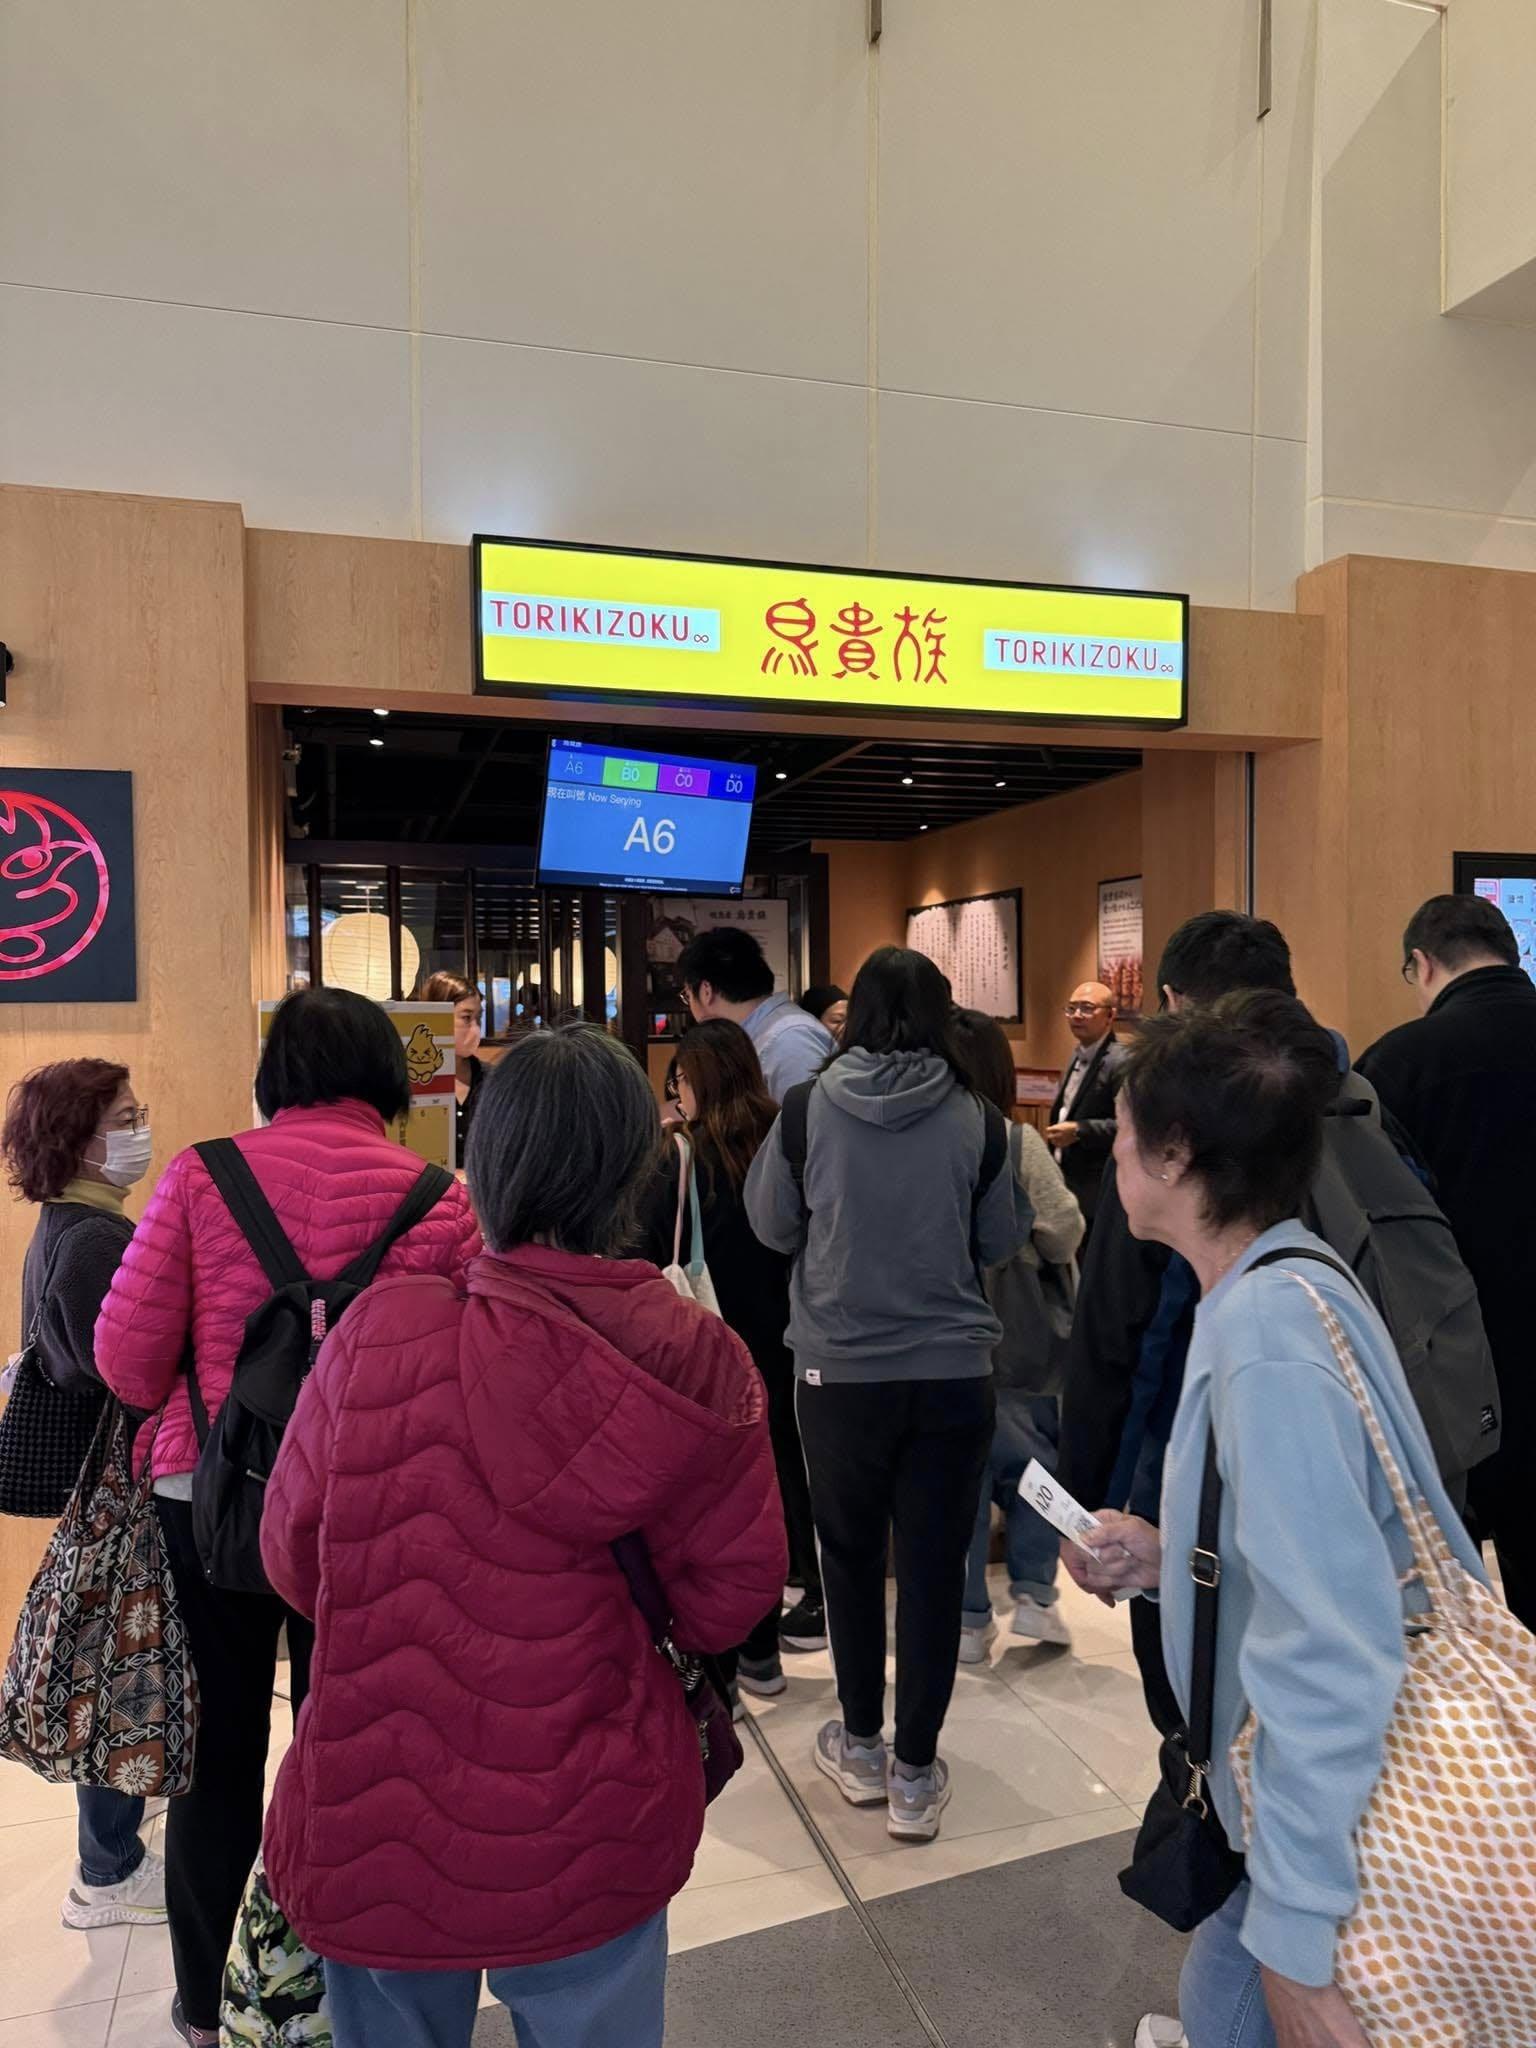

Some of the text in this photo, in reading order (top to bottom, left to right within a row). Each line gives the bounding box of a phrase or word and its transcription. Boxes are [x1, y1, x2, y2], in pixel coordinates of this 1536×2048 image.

[564, 761, 583, 775] A6
[587, 791, 609, 803] Now
[623, 816, 677, 855] A6
